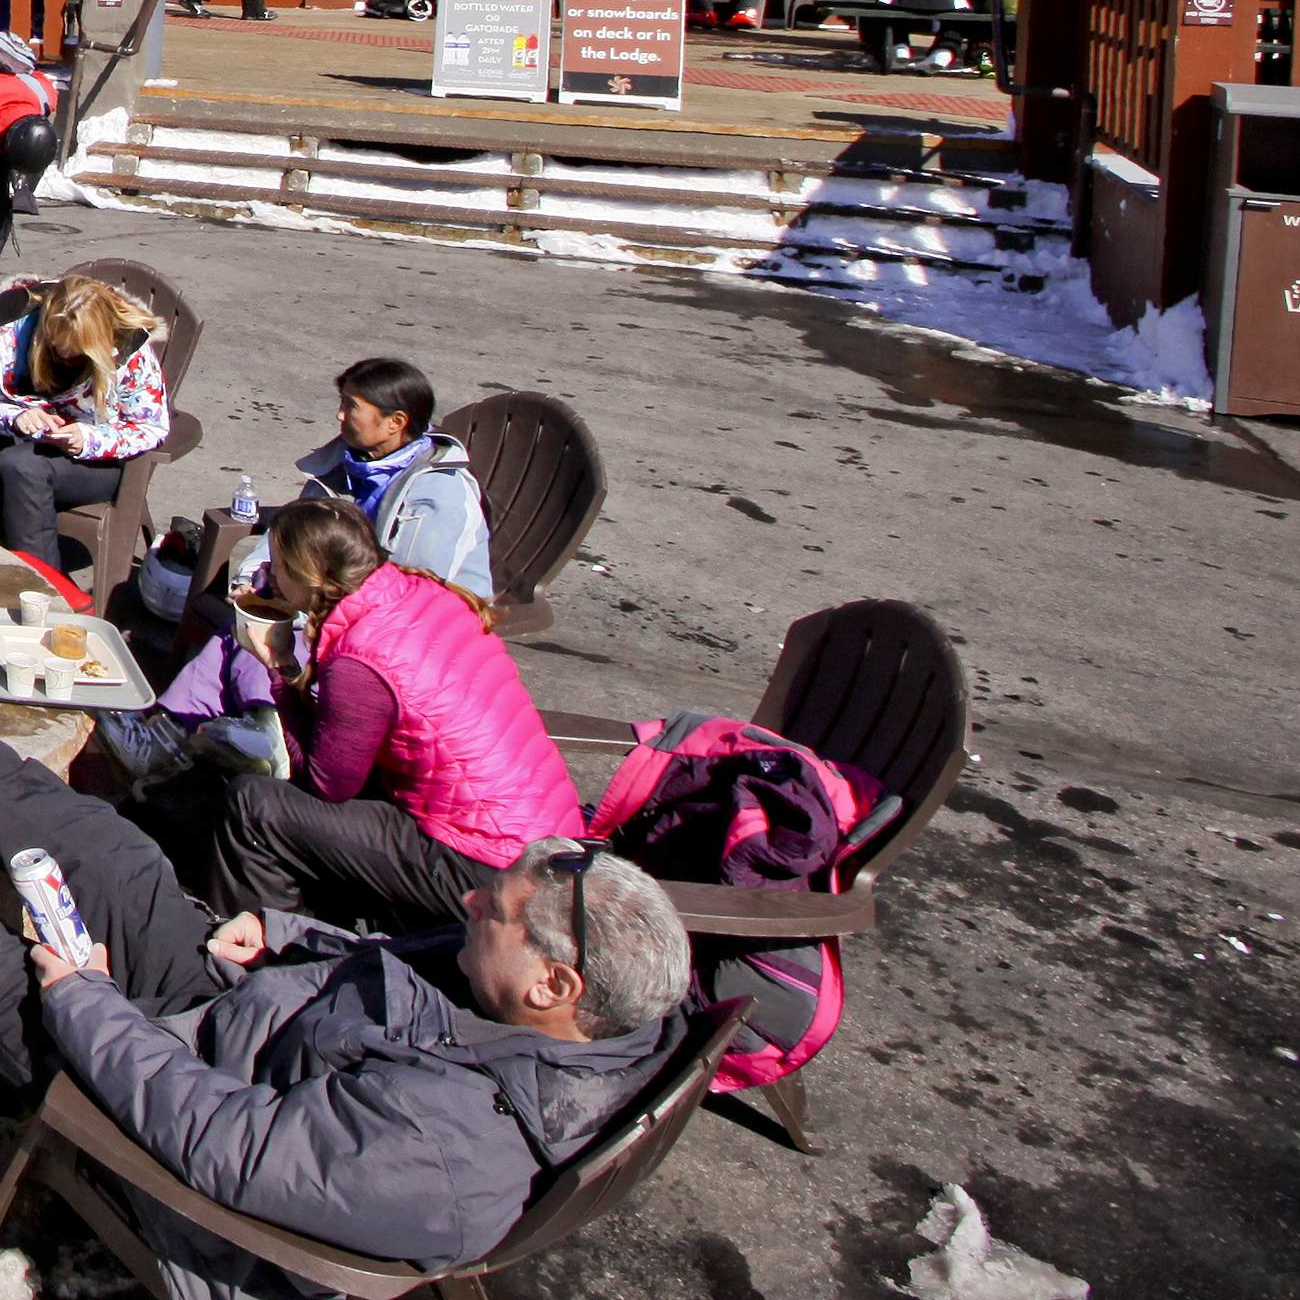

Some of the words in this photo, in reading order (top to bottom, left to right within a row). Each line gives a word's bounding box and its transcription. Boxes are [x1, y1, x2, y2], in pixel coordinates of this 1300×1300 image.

[454, 3, 499, 12] BOTTLED
[499, 4, 534, 13] WATER
[567, 8, 585, 17] or
[587, 6, 679, 20] snowboards
[485, 14, 501, 22] OR
[465, 23, 521, 34] GATORADE
[573, 28, 593, 38] on
[596, 26, 633, 40] deck
[636, 31, 654, 41] or
[656, 29, 671, 41] in
[477, 37, 505, 45] AFTER
[478, 55, 504, 64] DAILY
[581, 46, 606, 60] the
[610, 47, 662, 64] Lodge.
